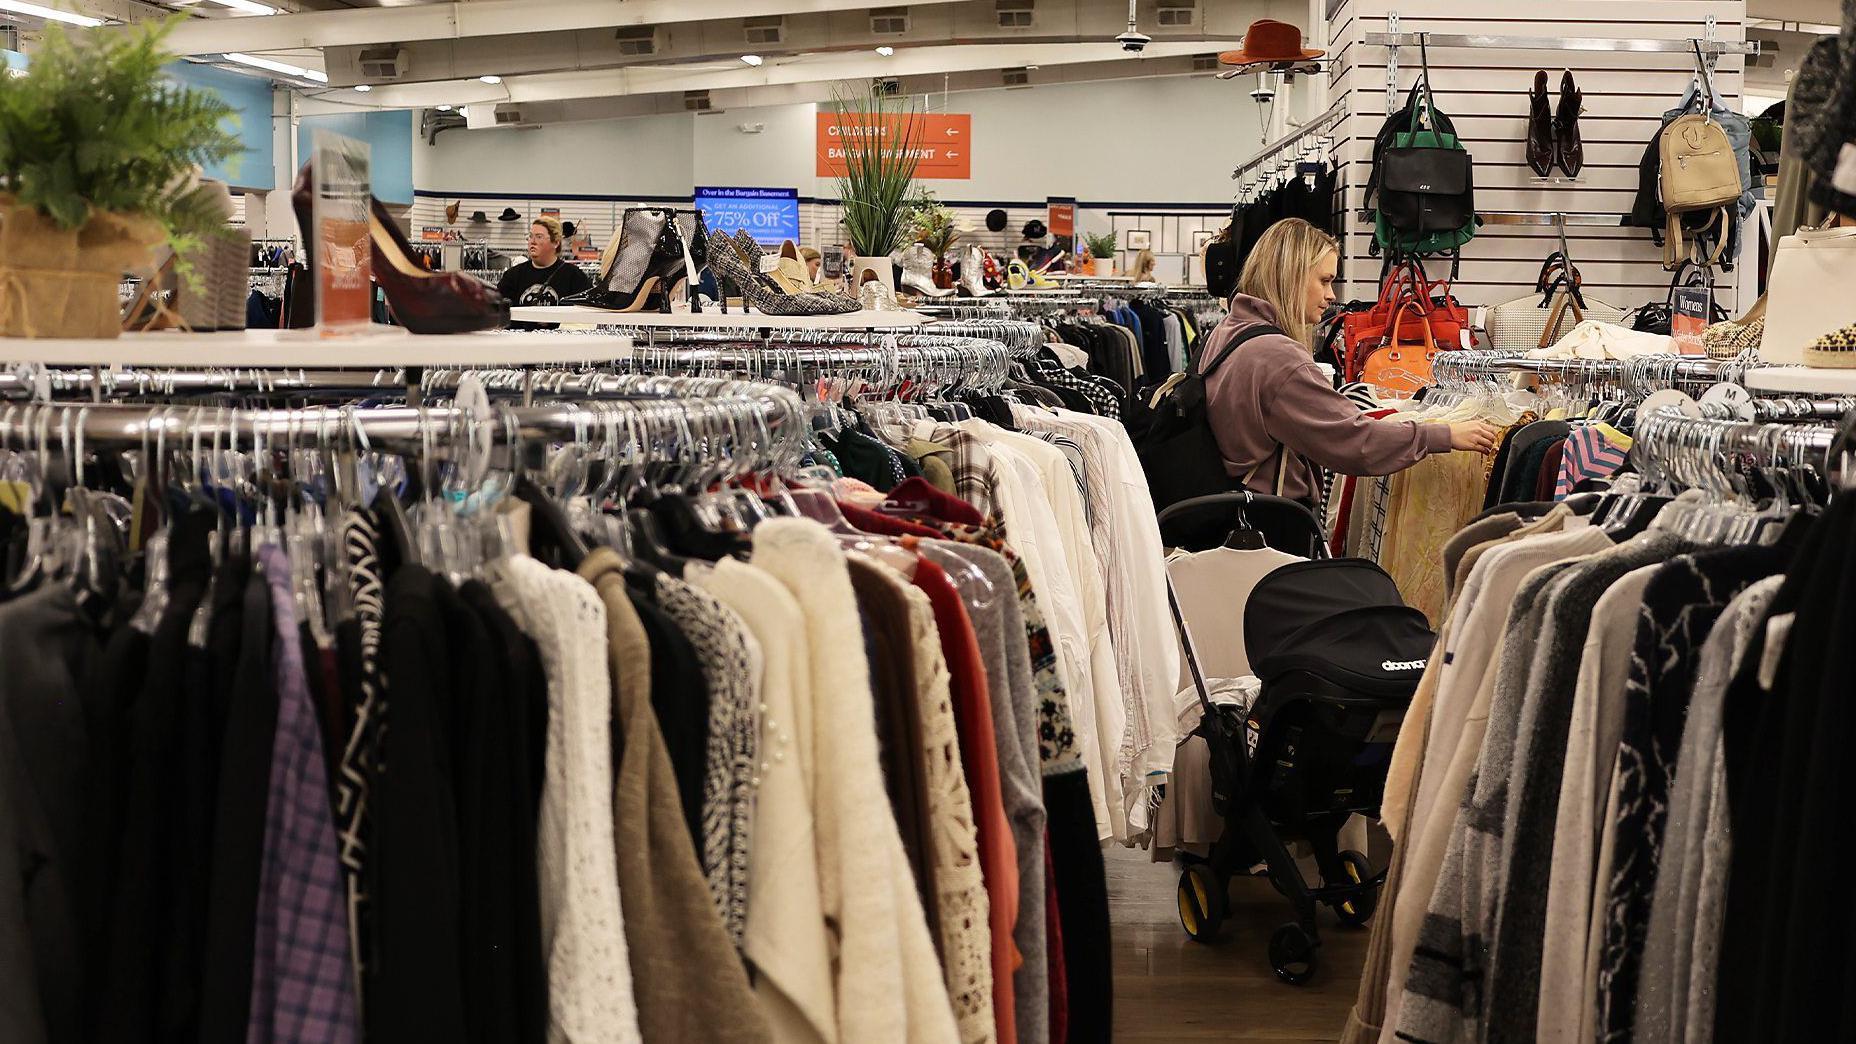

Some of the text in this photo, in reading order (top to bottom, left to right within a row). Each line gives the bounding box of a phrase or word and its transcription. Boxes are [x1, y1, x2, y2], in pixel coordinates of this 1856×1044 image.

[714, 211, 780, 227] 75% Off
[1680, 295, 1703, 312] Womens
[1725, 388, 1737, 400] M
